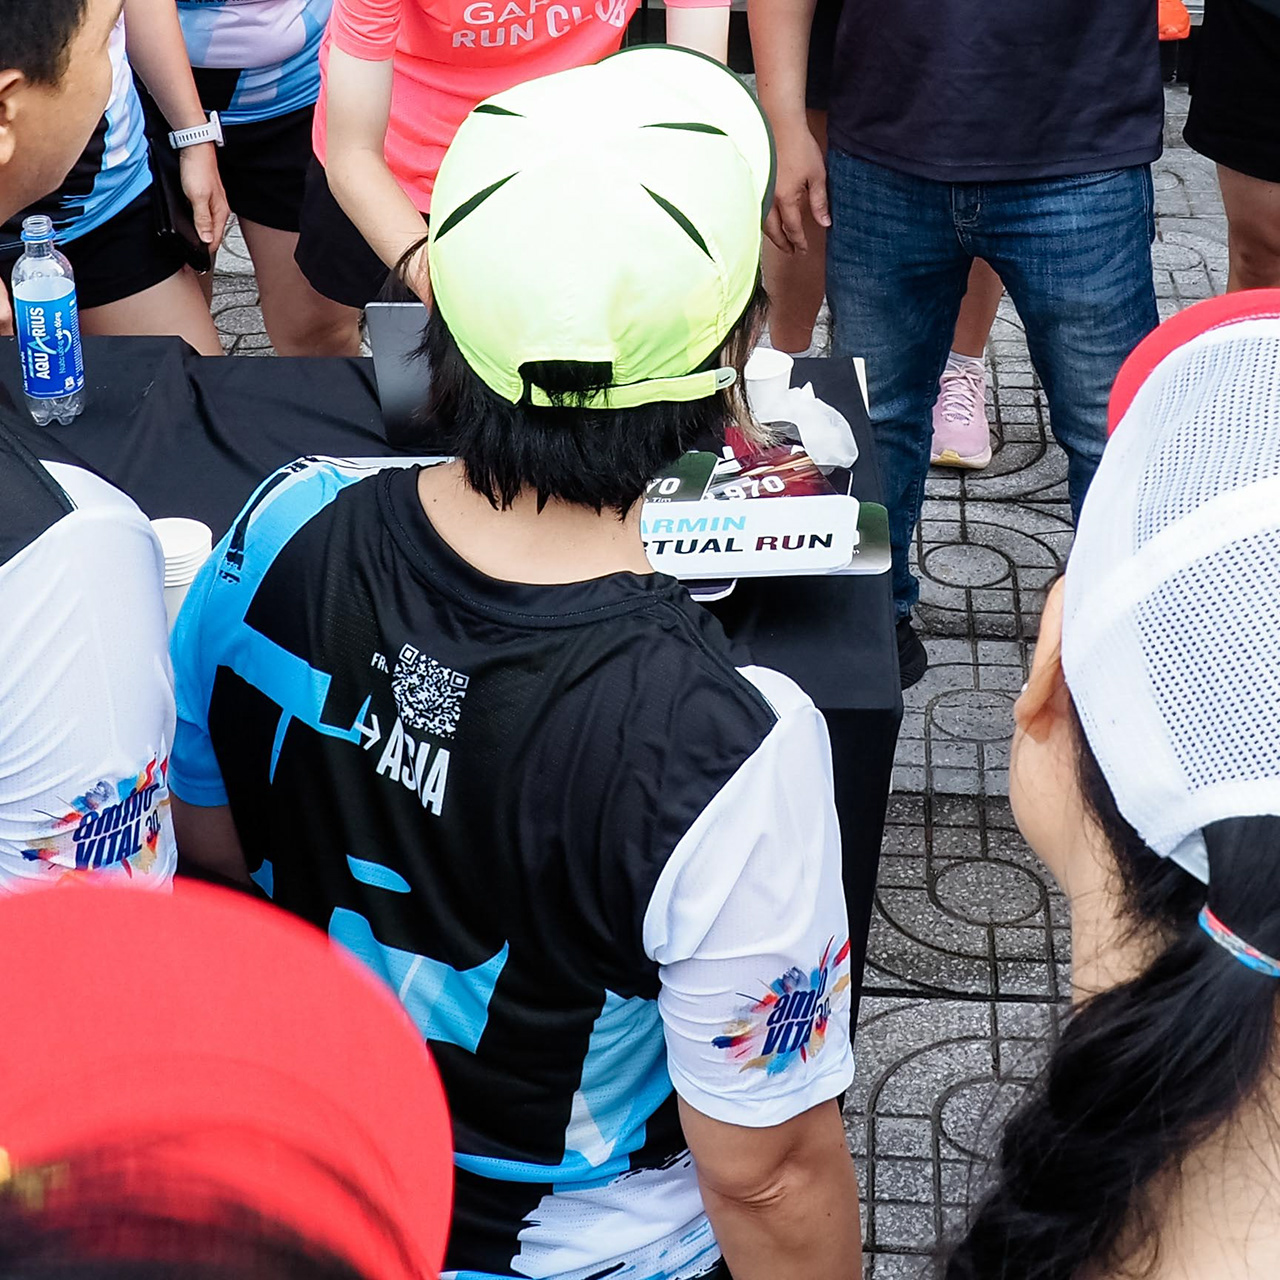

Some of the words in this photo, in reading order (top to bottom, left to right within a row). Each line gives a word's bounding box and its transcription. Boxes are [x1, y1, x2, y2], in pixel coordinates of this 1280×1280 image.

[452, 18, 534, 48] RUN
[27, 307, 58, 380] AQUARIUS
[642, 516, 747, 534] RMIN
[755, 533, 833, 552] RUN
[376, 716, 450, 817] ASIA
[72, 783, 160, 843] amino
[75, 819, 142, 870] VITAL
